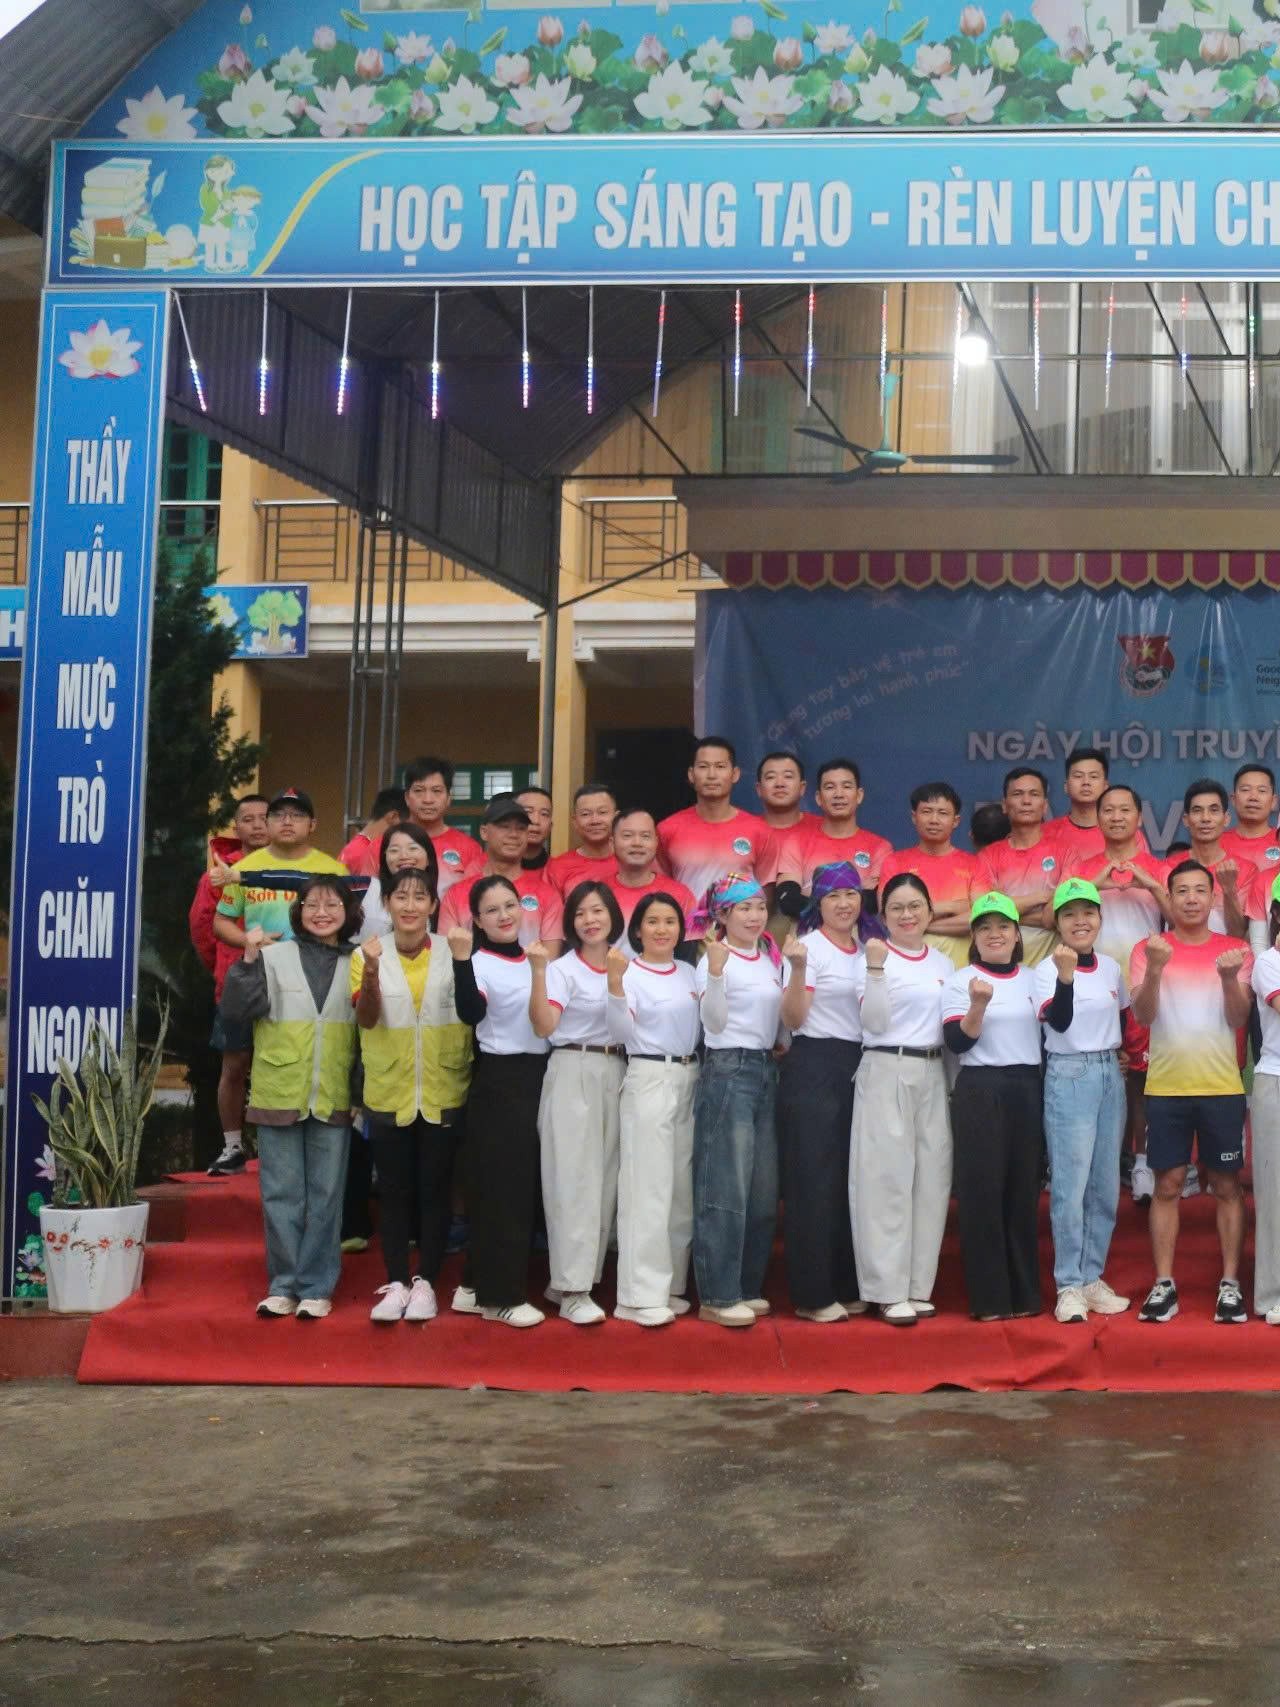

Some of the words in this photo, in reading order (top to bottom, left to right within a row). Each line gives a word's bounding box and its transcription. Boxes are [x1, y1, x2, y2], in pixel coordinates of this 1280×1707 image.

[360, 185, 464, 266] HỌC
[481, 169, 577, 264] TẬP
[593, 168, 737, 251] SÁNG
[754, 181, 853, 262] TẠO
[907, 166, 1013, 246] RÈN
[1030, 166, 1197, 261] LUYỆN
[66, 416, 131, 504] THẦY
[61, 523, 122, 617] MẪU
[56, 656, 117, 745] MỰC
[967, 720, 1082, 761] NGÀY
[1092, 720, 1161, 768] HỘI
[57, 759, 106, 844] TRÒ
[38, 876, 115, 958] CHĂM
